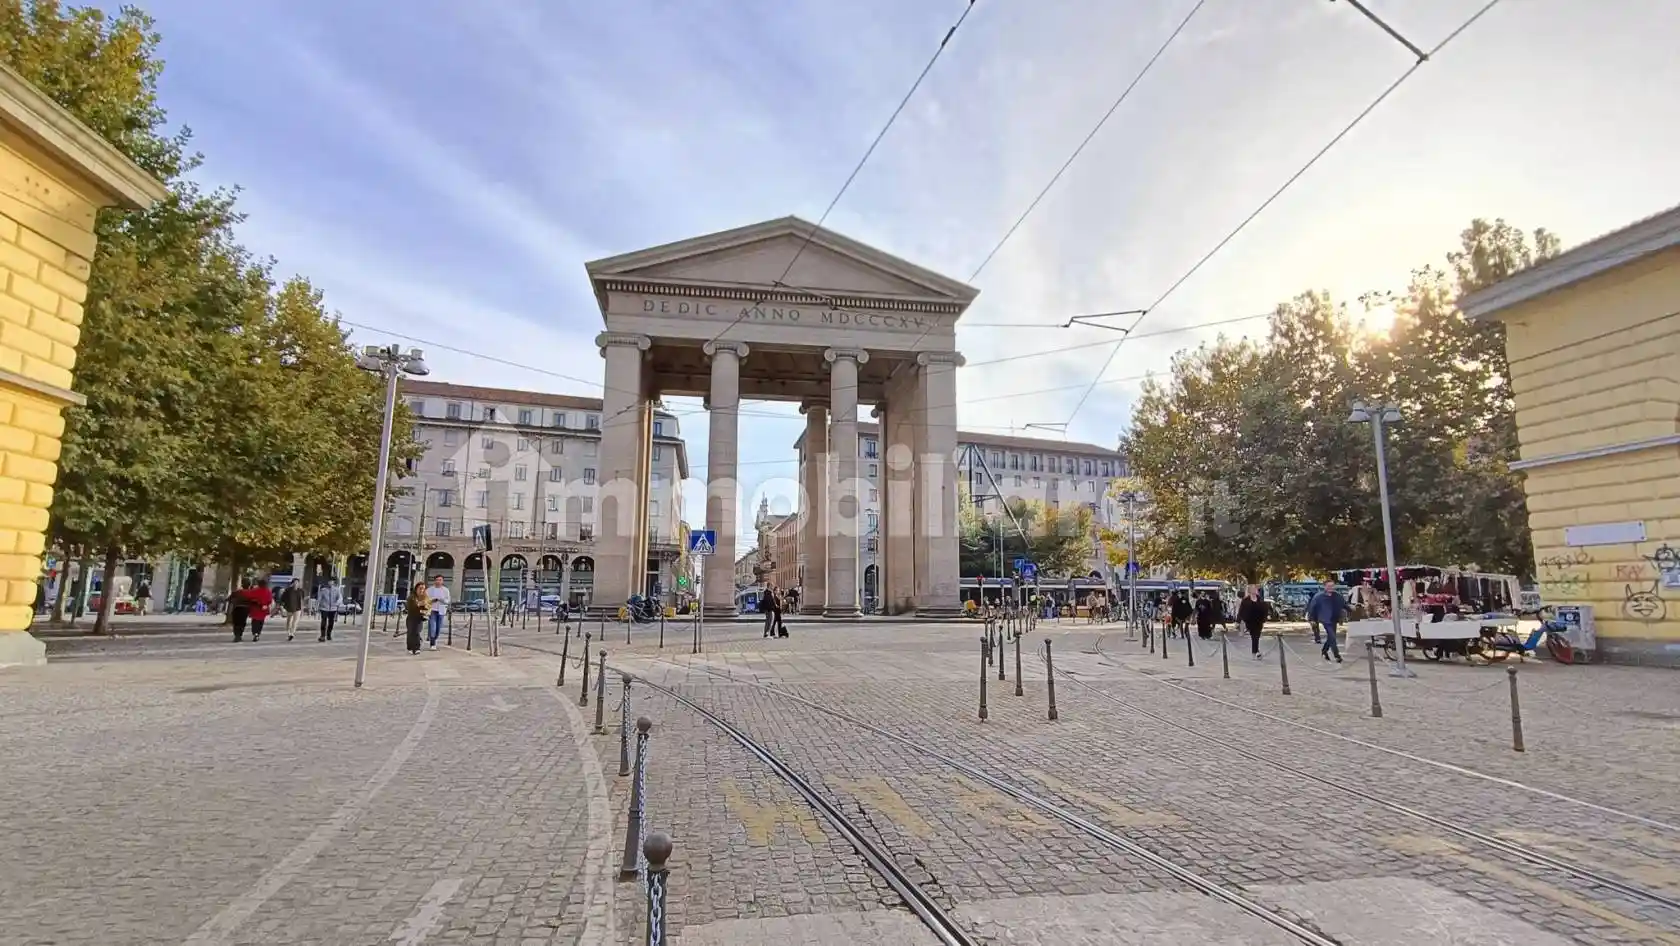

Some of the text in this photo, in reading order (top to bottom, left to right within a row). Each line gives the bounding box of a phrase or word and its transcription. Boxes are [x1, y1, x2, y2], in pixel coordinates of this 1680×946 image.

[643, 299, 926, 328] DEDIC ANNO MDCCCXV
